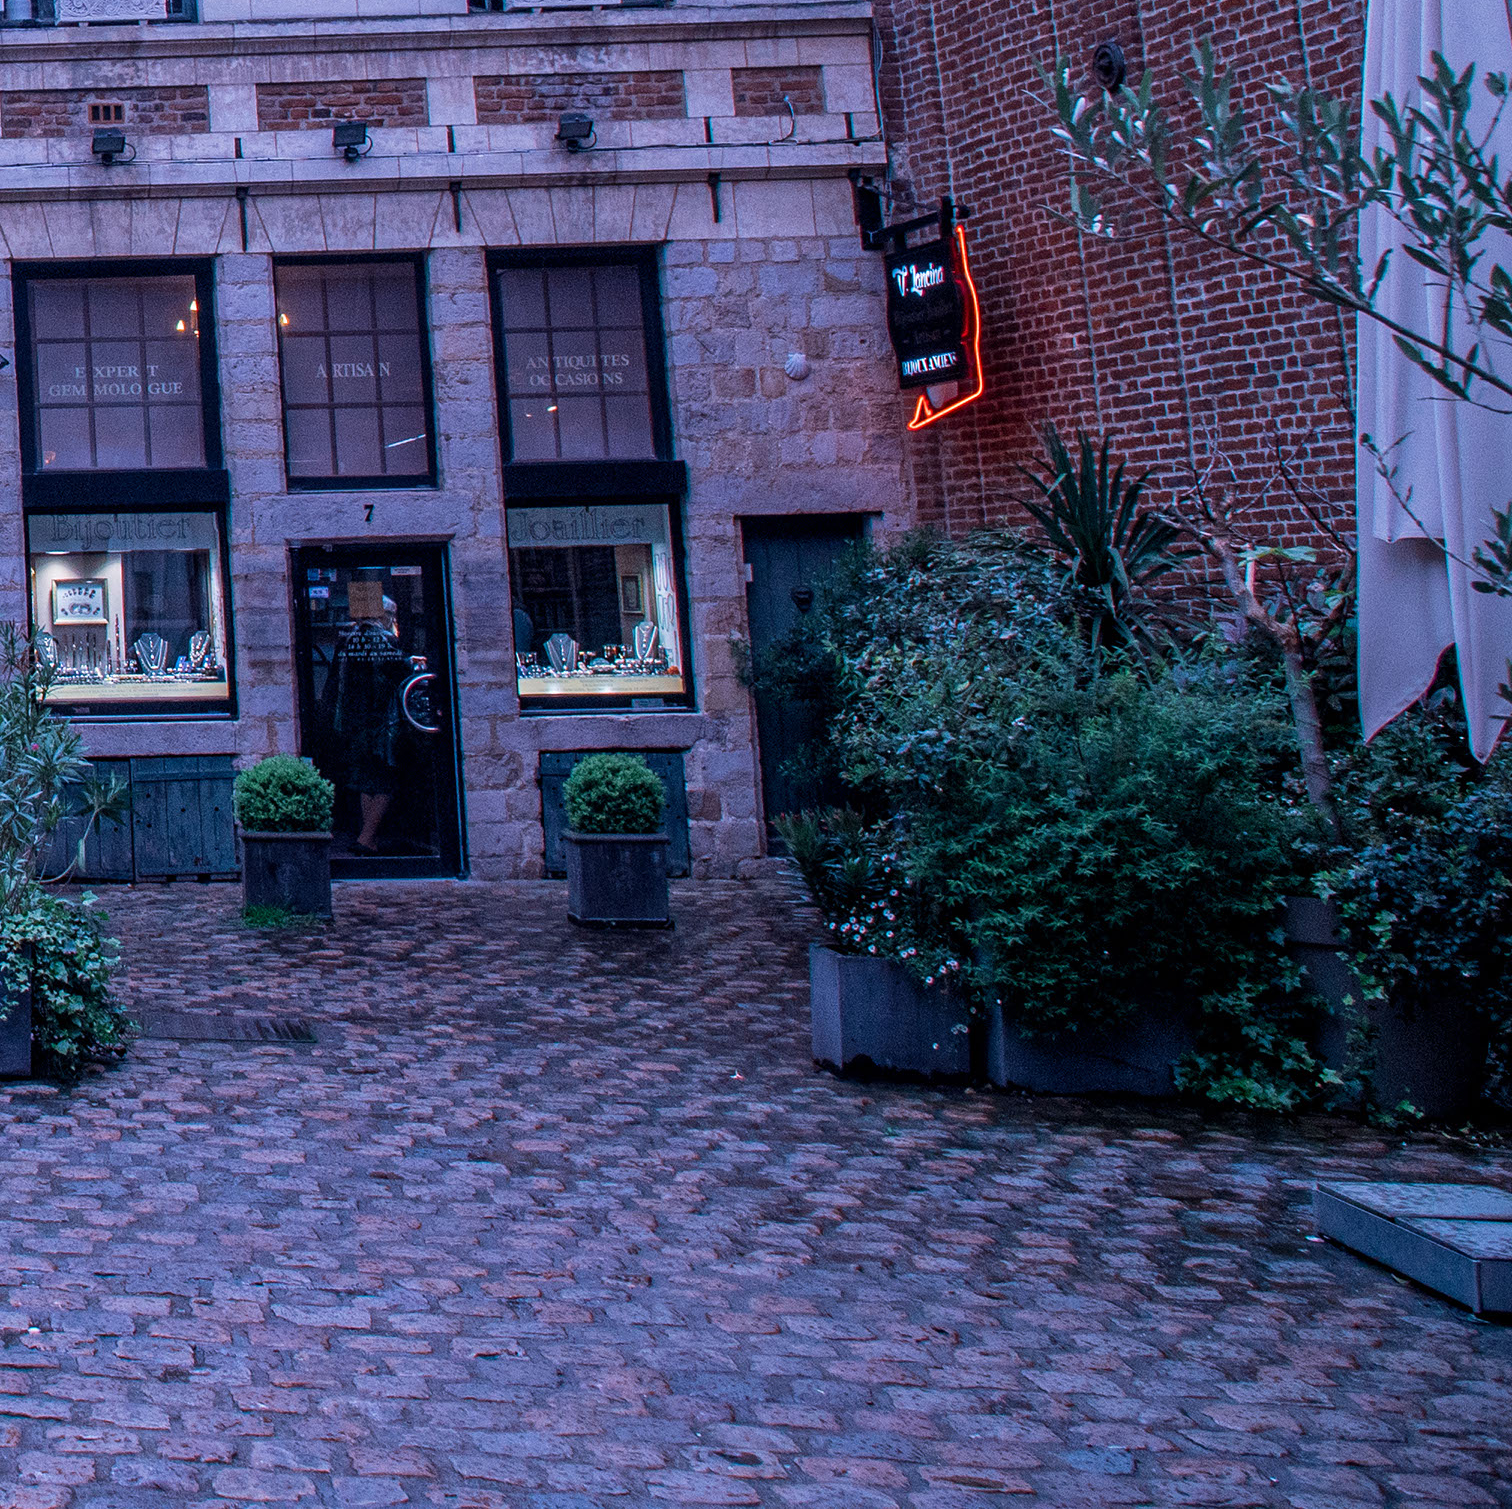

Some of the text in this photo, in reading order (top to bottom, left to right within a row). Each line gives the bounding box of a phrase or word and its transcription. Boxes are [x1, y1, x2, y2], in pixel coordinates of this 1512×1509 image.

[316, 362, 391, 378] ARTISAN
[526, 354, 630, 370] ANTIQUITES
[75, 364, 159, 379] EXPERT
[529, 372, 624, 387] OCCASIONS
[49, 381, 184, 397] GEMMOLOGUE
[363, 503, 375, 523] 7
[51, 513, 191, 550] Bijoutier
[511, 507, 645, 542] Joaillier
